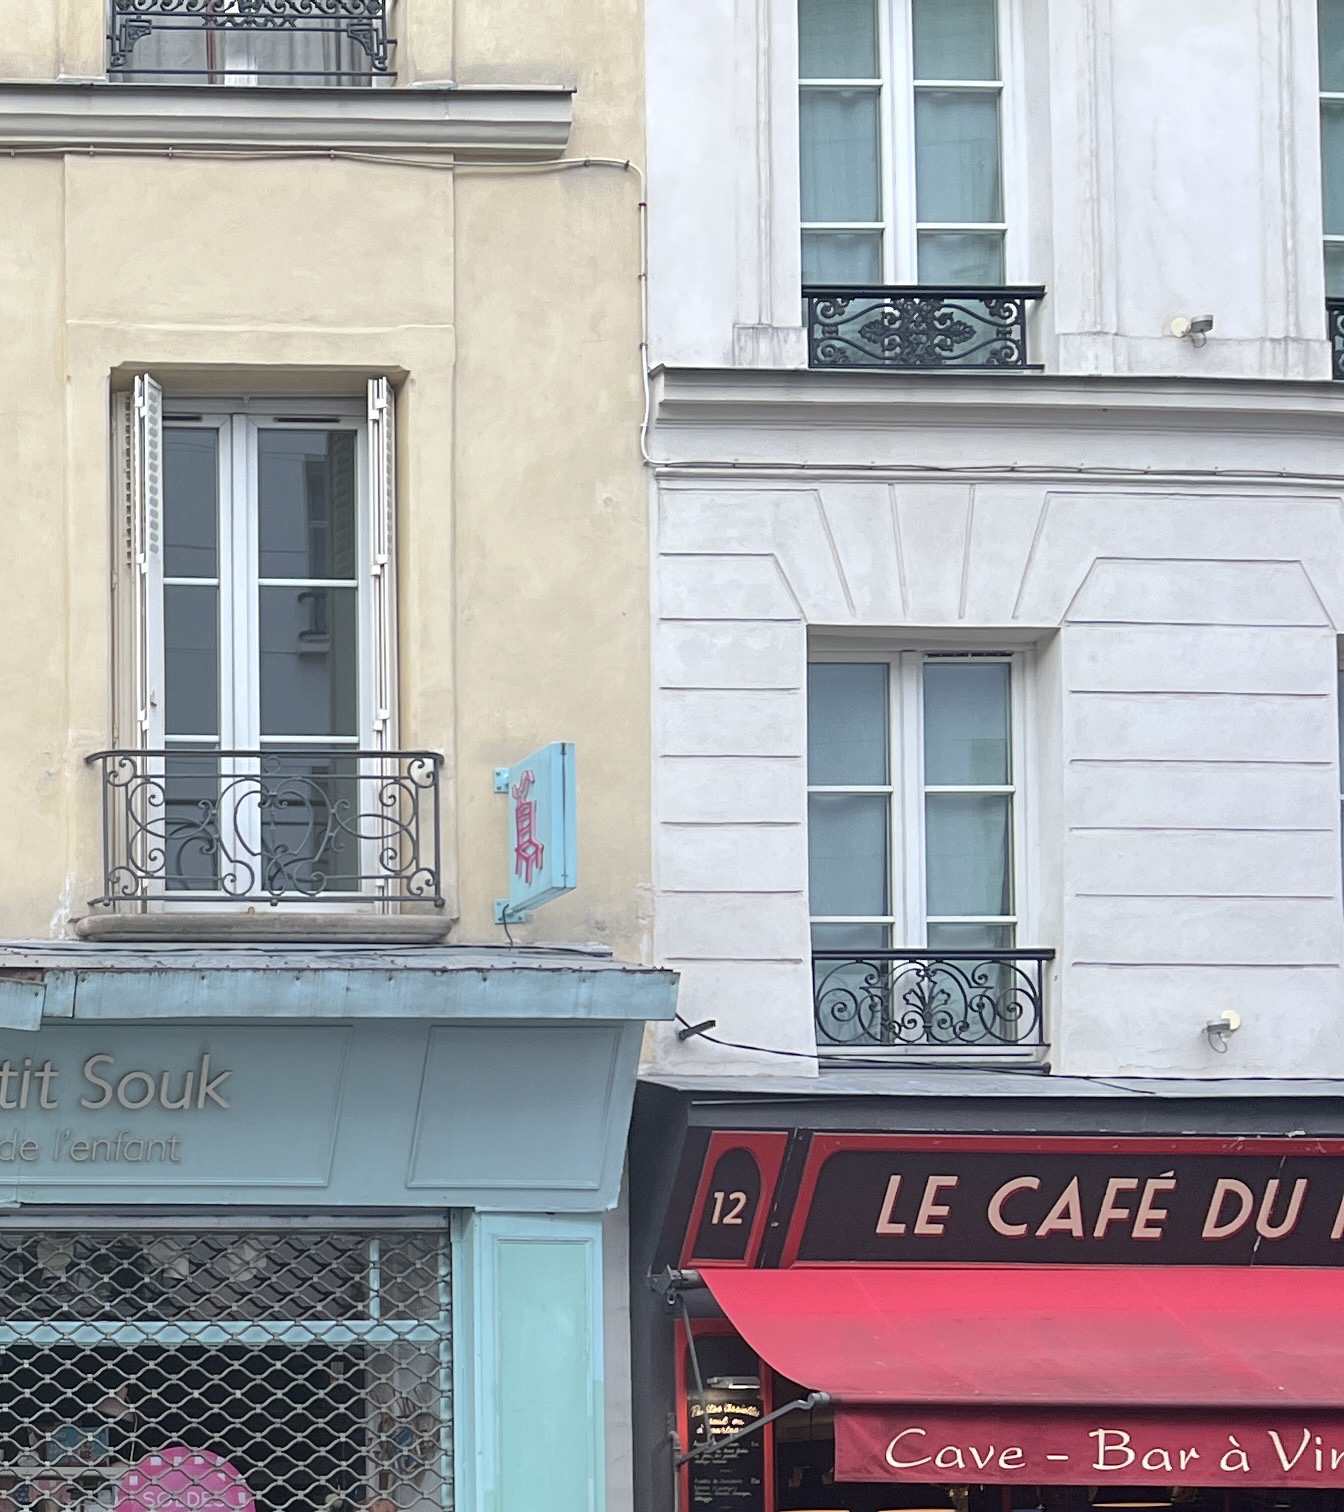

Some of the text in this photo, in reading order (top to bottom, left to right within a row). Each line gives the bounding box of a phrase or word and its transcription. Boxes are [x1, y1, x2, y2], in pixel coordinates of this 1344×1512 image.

[79, 1053, 233, 1110] Souk
[52, 1128, 182, 1163] l'enfant
[712, 1191, 747, 1225] 12
[876, 1174, 959, 1236] LE
[987, 1171, 1178, 1239] CAFÉ
[1201, 1178, 1310, 1241] DU
[885, 1428, 1027, 1470] Cave
[1088, 1428, 1201, 1472] Bar
[1220, 1435, 1251, 1472] à
